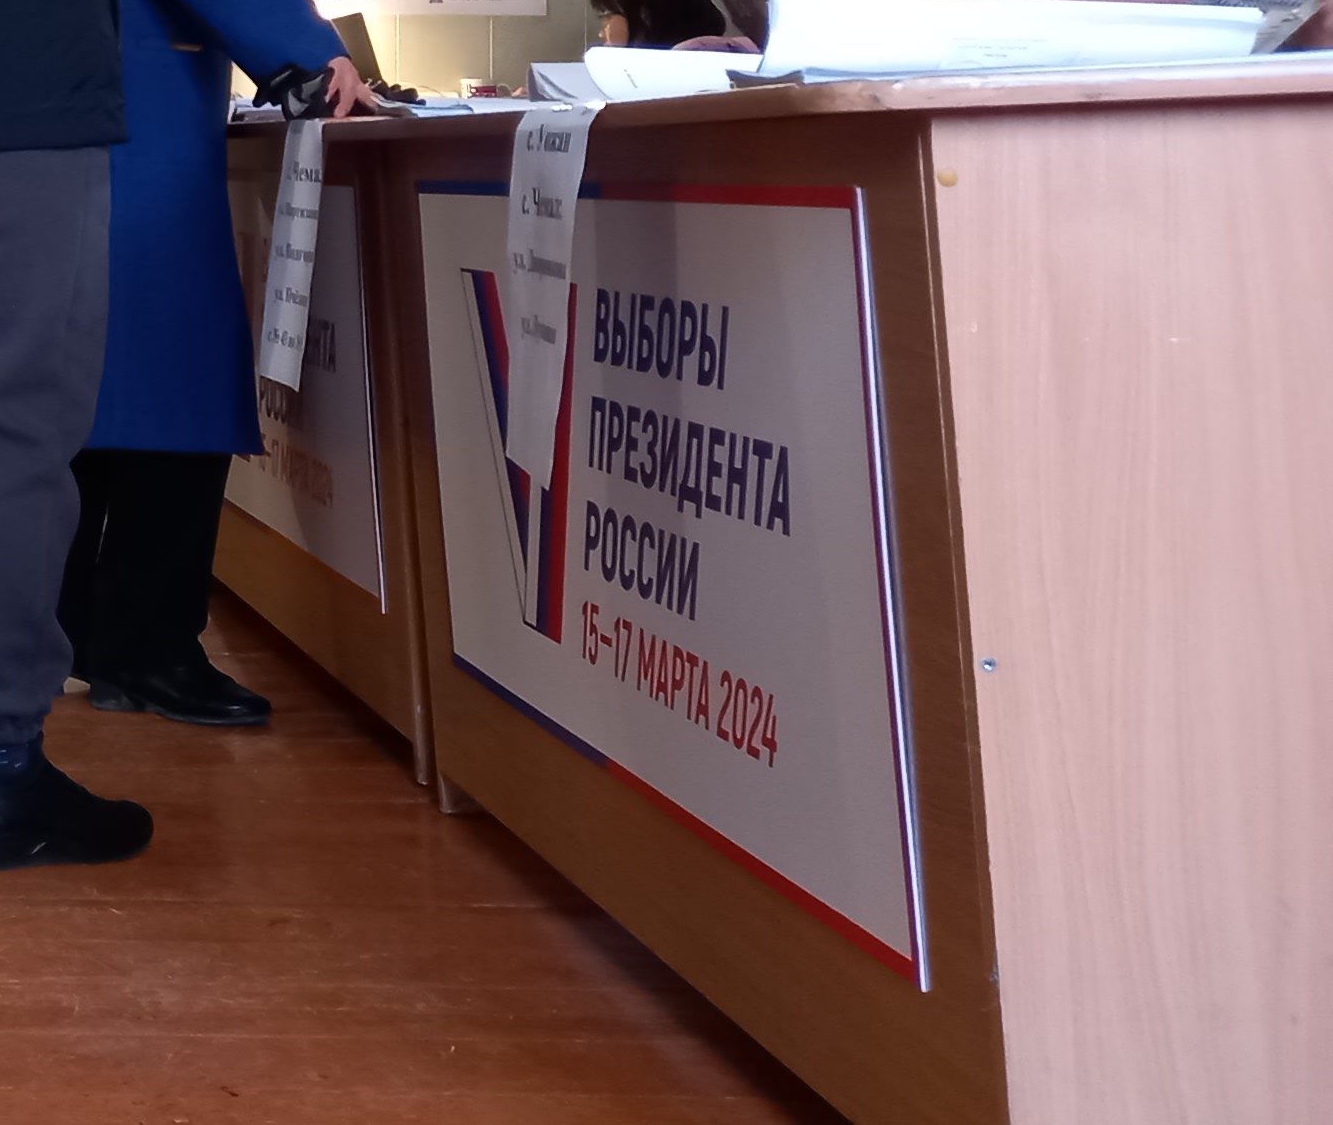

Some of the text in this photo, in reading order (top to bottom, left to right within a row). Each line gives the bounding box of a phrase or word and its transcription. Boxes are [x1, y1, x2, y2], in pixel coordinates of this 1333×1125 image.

[593, 288, 730, 391] ВЫБОРЫ
[588, 395, 791, 537] ПРЕЗИДЕНТА
[583, 499, 701, 621] РОССИИ
[636, 627, 710, 731] МАРТА
[716, 669, 778, 768] 2024
